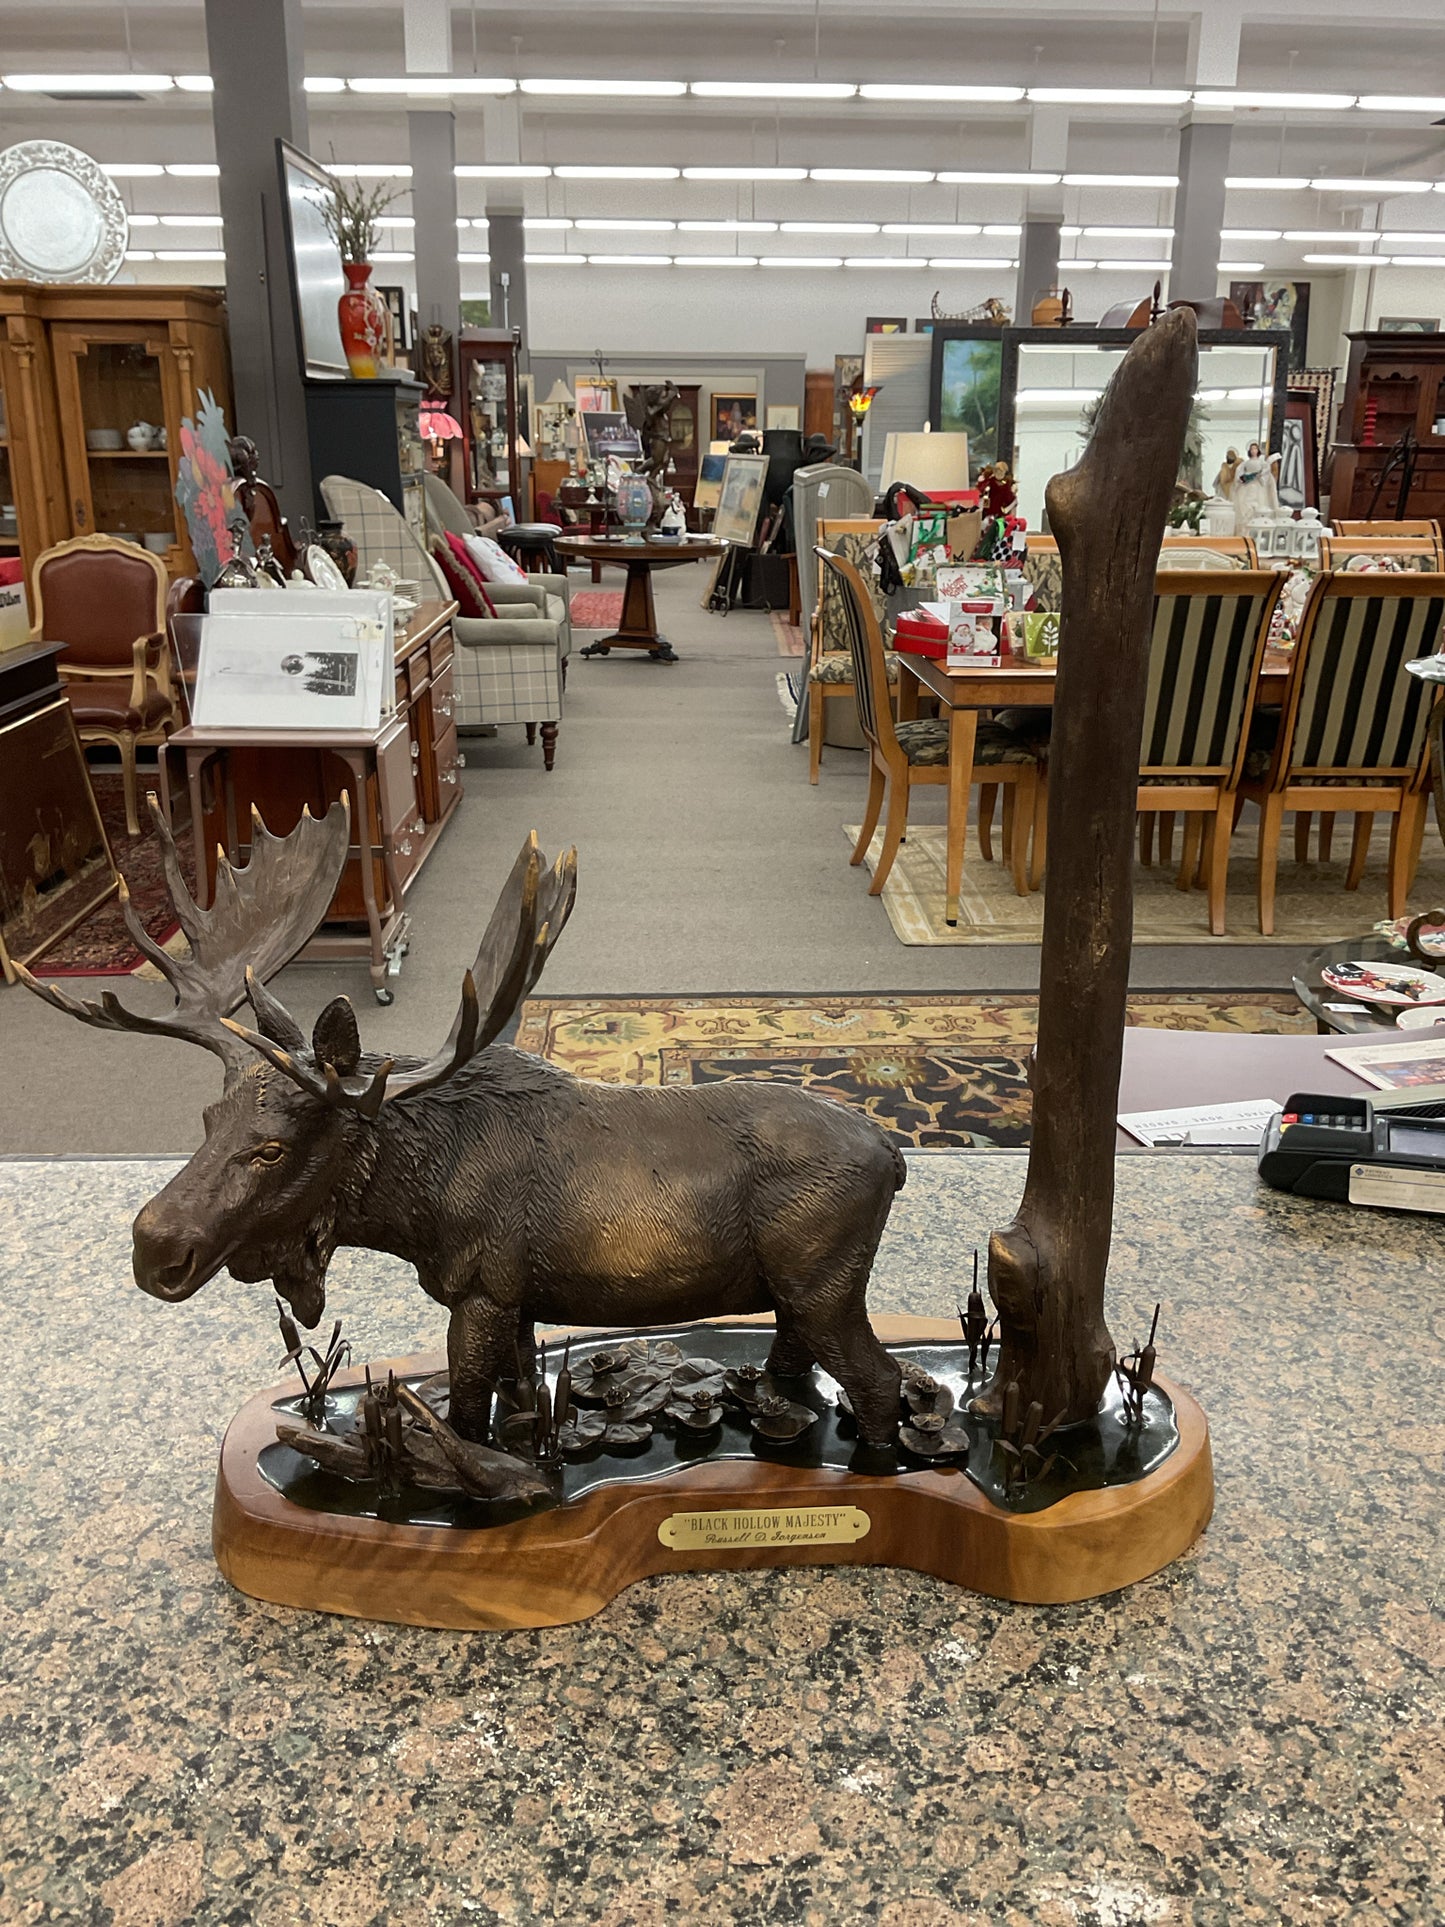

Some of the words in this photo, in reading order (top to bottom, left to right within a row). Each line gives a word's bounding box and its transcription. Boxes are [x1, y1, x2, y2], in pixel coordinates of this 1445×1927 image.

[1134, 1120, 1179, 1129] GARDEN
[1192, 1115, 1224, 1123] HOME
[684, 1517, 728, 1531] "BLACK
[733, 1515, 780, 1530] HOLLOW
[785, 1512, 846, 1528] MAJESTY"
[704, 1532, 752, 1544] Russell
[754, 1531, 767, 1542] D.
[771, 1530, 827, 1544] Jorgensen
